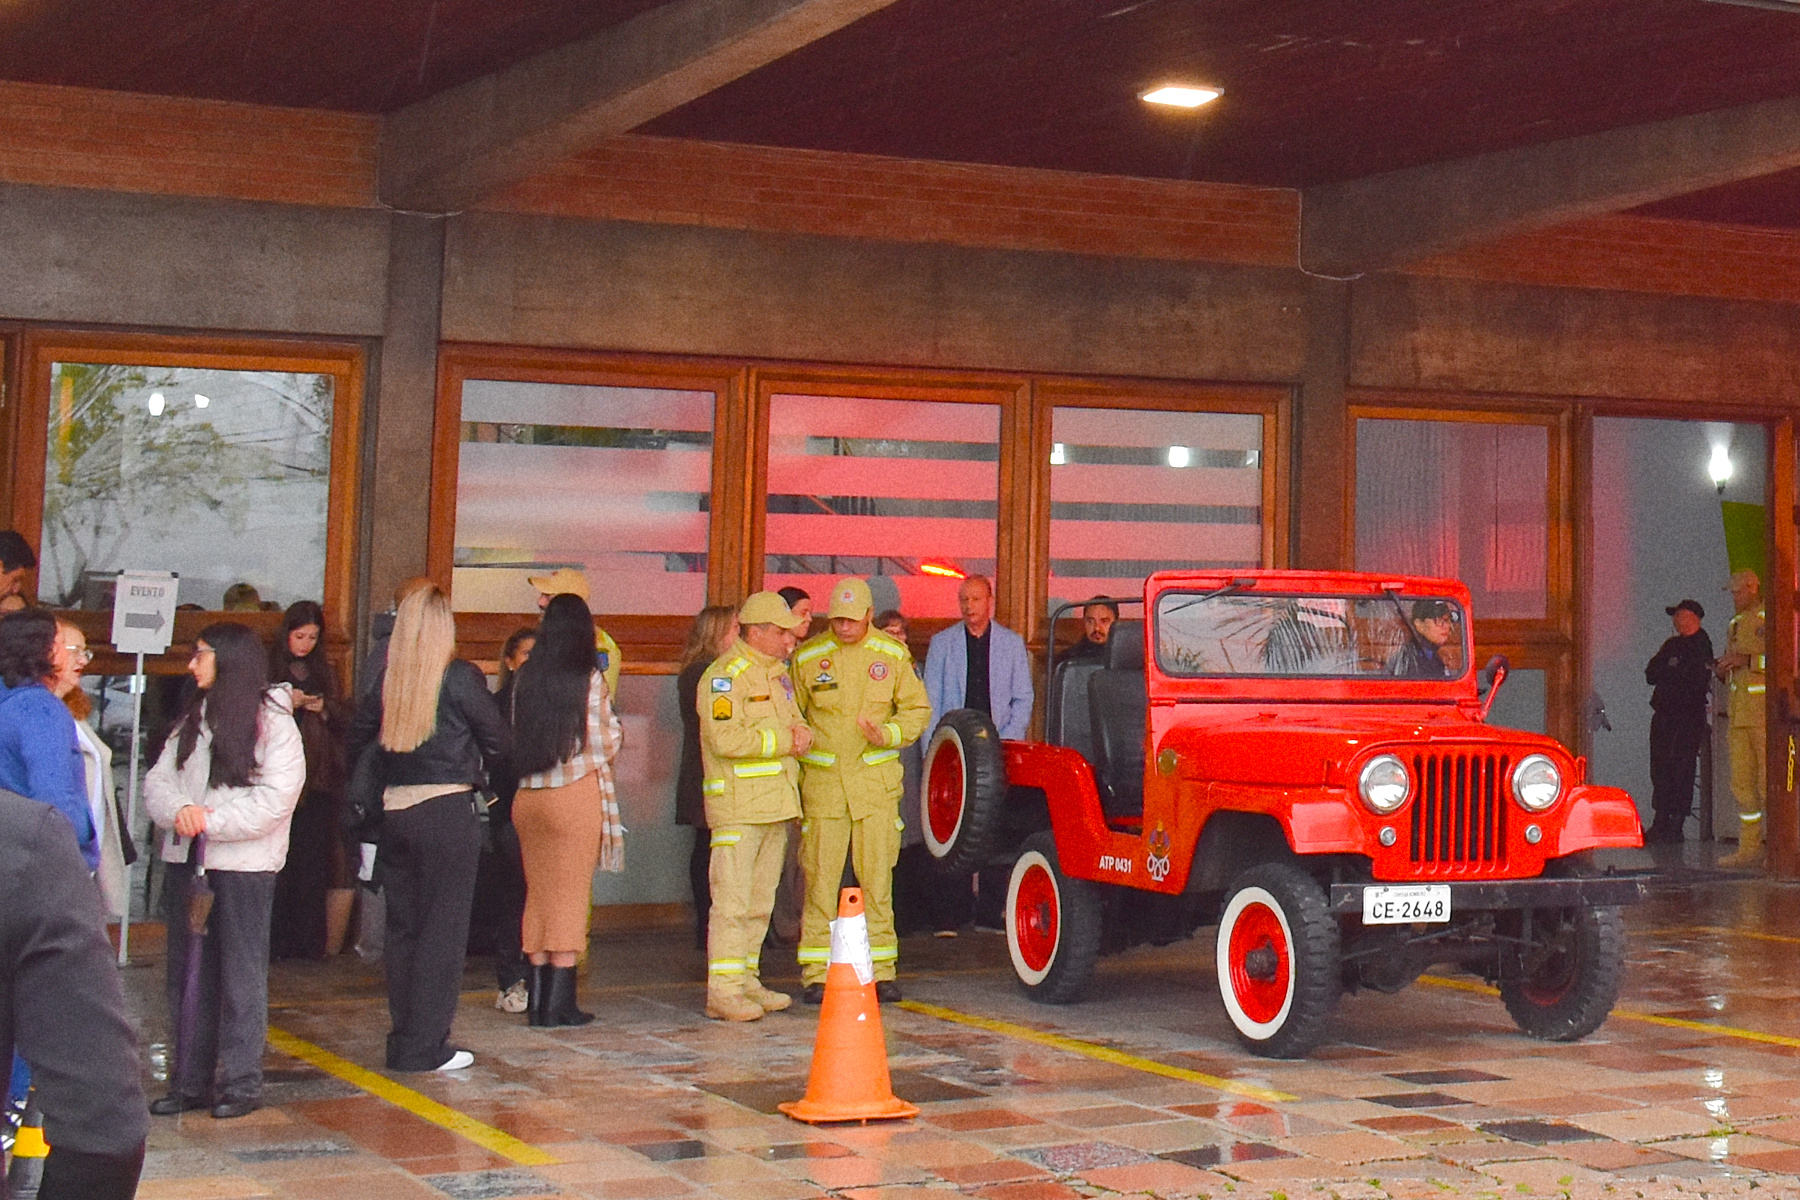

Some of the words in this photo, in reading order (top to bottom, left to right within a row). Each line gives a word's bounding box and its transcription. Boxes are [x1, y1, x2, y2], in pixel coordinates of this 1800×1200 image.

[130, 585, 165, 597] EVENTO
[1099, 855, 1114, 870] ATP
[1115, 857, 1131, 873] 0431
